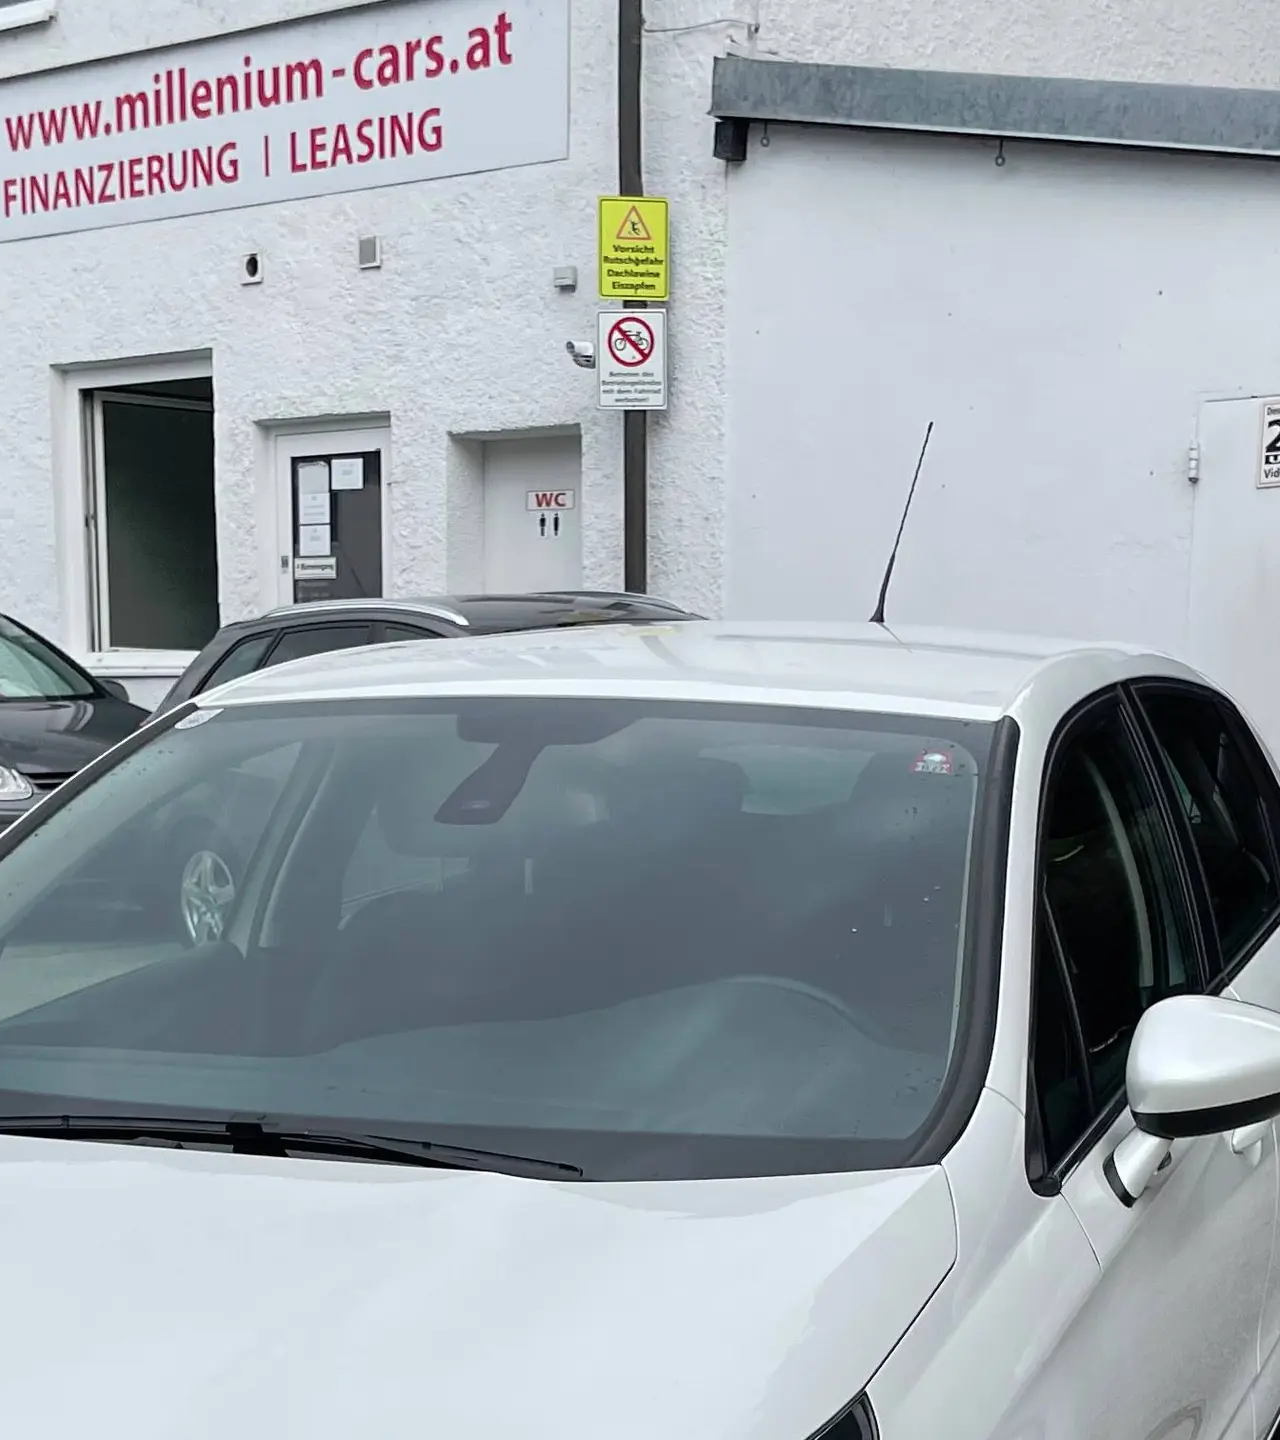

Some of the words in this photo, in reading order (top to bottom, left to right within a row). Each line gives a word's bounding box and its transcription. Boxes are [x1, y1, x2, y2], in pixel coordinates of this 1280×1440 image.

[5, 12, 514, 152] www.millenium-cars.at
[3, 142, 239, 218] FINANZIERUNG
[290, 107, 443, 174] LEASING
[535, 492, 567, 508] WC
